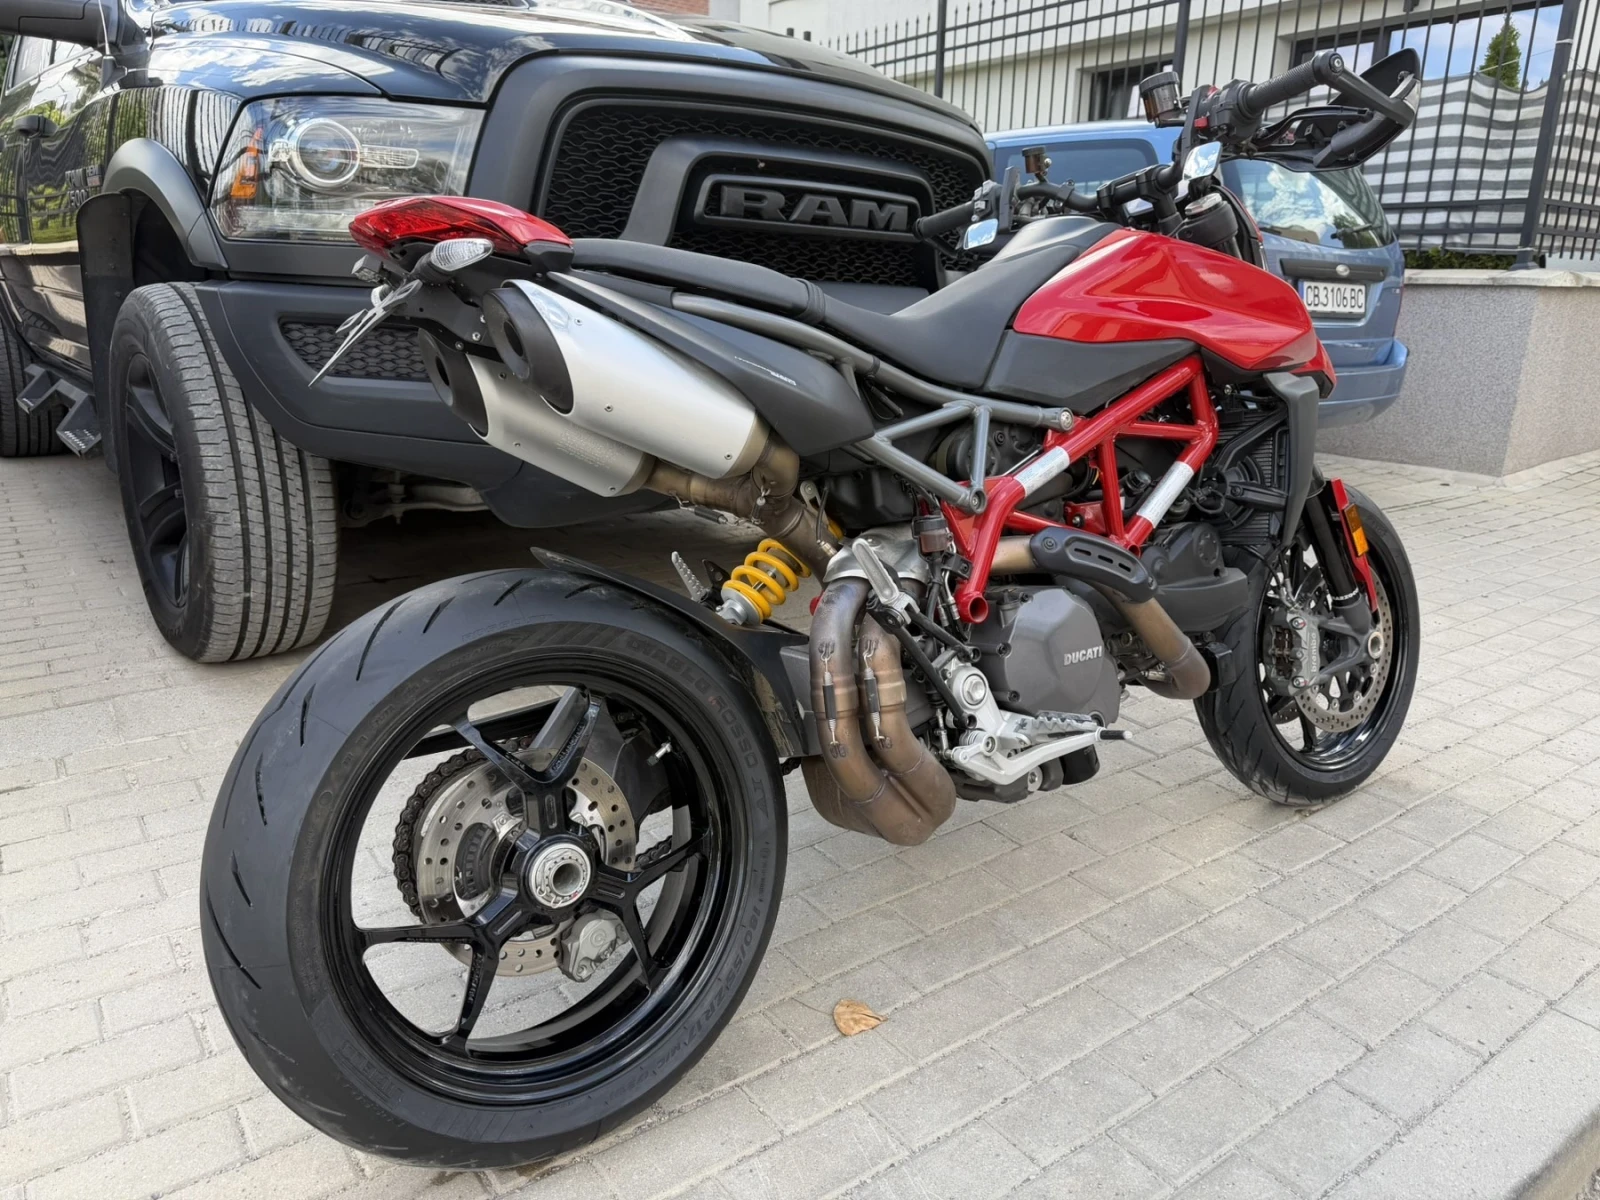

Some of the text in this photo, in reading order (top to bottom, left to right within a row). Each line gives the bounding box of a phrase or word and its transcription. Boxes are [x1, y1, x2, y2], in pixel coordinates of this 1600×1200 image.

[720, 185, 908, 231] RAM
[1306, 285, 1364, 309] CB 3106 BC
[1063, 645, 1102, 666] DUCATI
[626, 637, 711, 695] DIABLO
[708, 694, 760, 769] ROSSO
